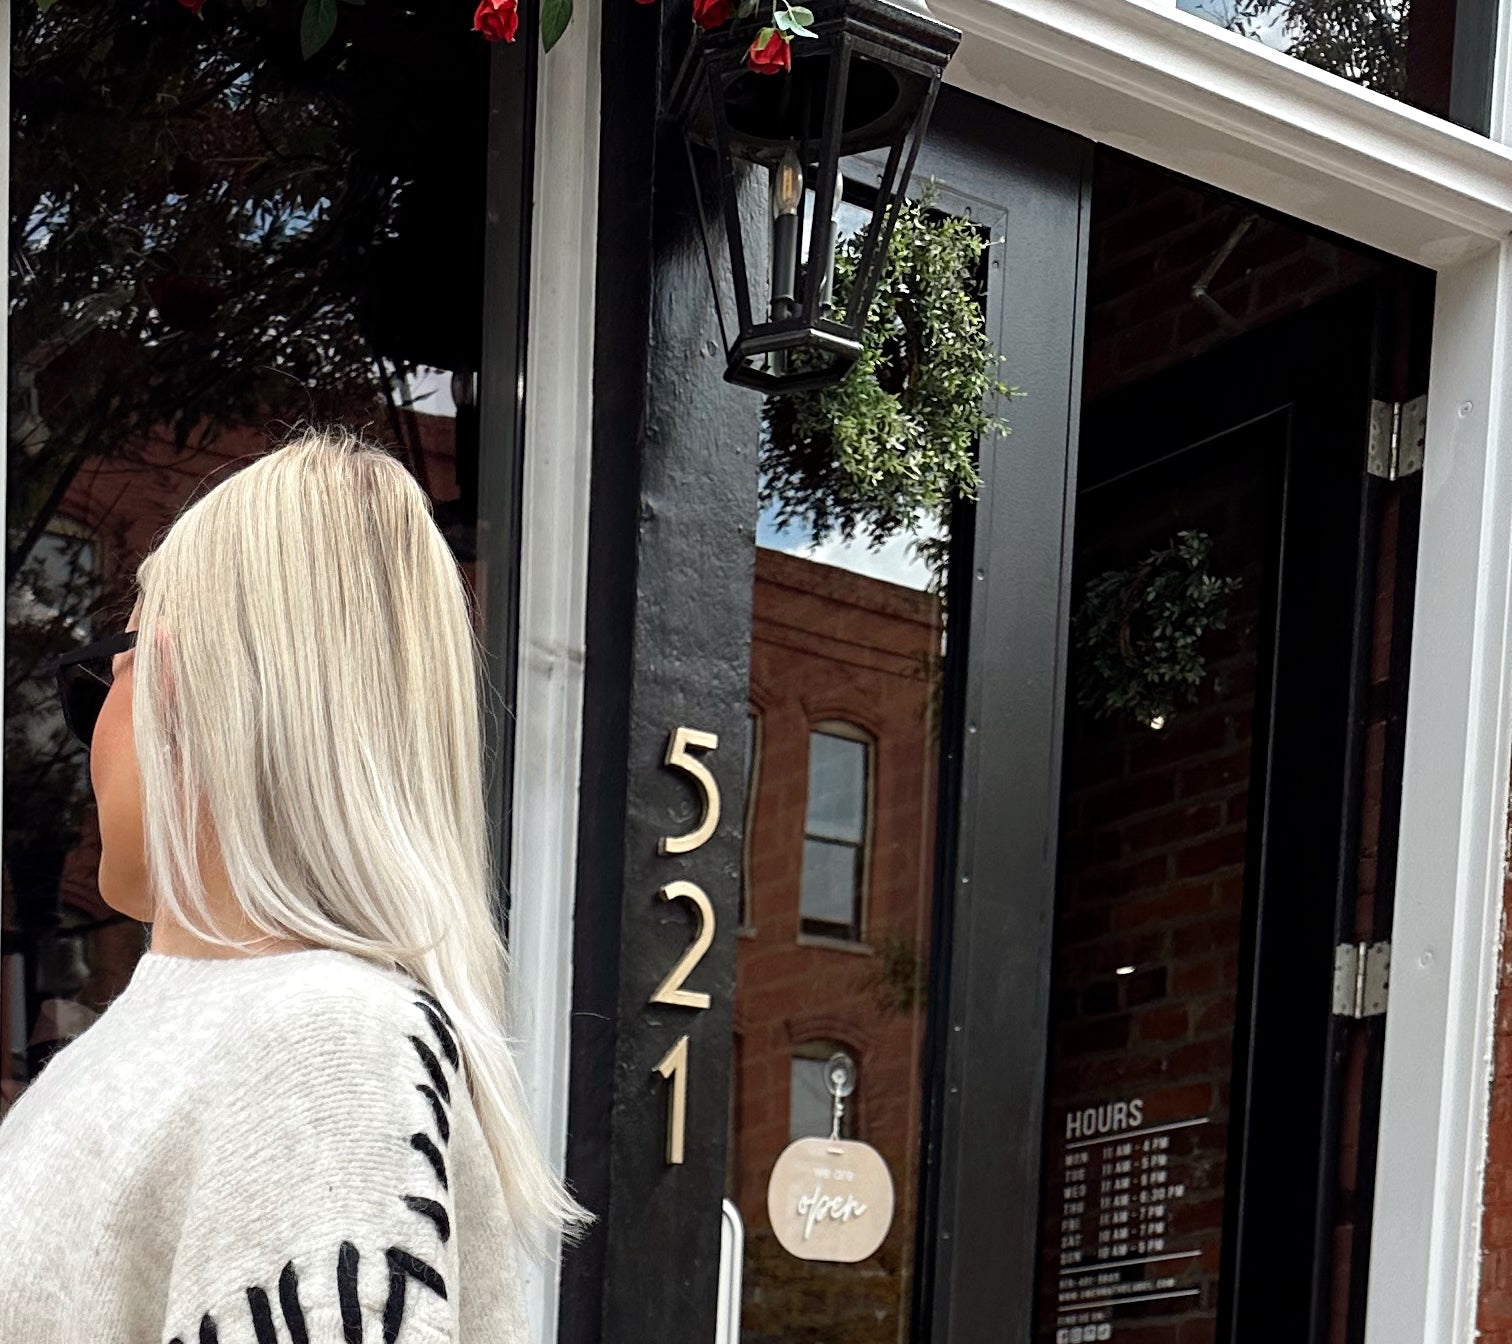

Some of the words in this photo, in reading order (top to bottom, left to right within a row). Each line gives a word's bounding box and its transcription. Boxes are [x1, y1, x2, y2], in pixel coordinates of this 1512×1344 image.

[650, 725, 721, 1165] 521
[1065, 1098, 1144, 1139] HOURS
[1116, 1143, 1132, 1157] AM
[1152, 1136, 1169, 1151] PM
[1114, 1159, 1132, 1174] AM
[1150, 1153, 1168, 1167] PM
[813, 1167, 831, 1179] we
[833, 1168, 855, 1182] are
[1114, 1176, 1130, 1190] AM
[1149, 1170, 1167, 1185] PM
[1113, 1193, 1130, 1207] AM
[1167, 1183, 1186, 1199] PM
[797, 1186, 867, 1239] open
[1112, 1210, 1129, 1224] AM
[1147, 1203, 1166, 1218] PM
[1113, 1226, 1129, 1241] AM
[1147, 1219, 1166, 1235] PM
[1112, 1242, 1129, 1256] AM
[1147, 1237, 1165, 1252] PM
